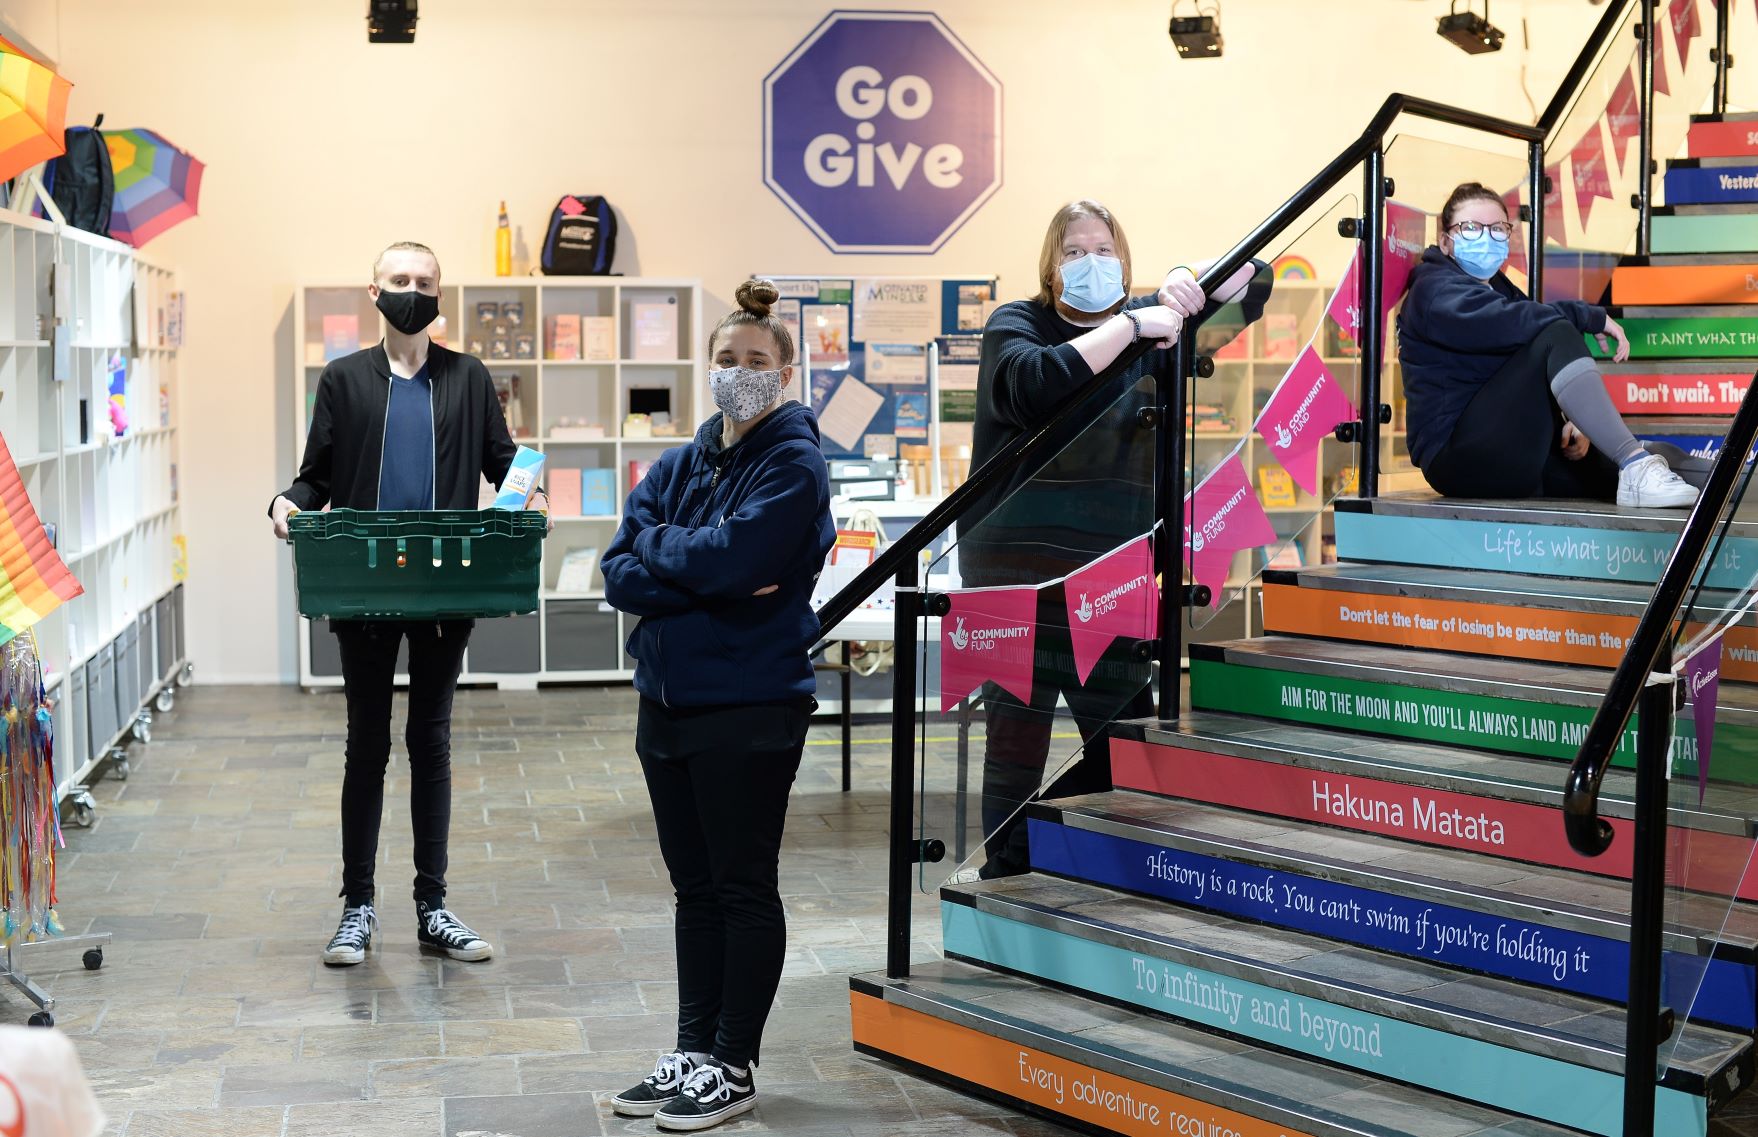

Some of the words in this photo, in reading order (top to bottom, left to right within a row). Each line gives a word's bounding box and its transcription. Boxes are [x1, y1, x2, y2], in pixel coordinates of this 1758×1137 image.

[835, 65, 933, 120] Go
[803, 121, 964, 191] Give
[1646, 333, 1657, 346] IT
[1661, 332, 1693, 346] AIN'T
[1696, 332, 1736, 345] WHAT
[1740, 332, 1758, 345] TH
[1288, 373, 1327, 429] COMMUNITY
[1627, 382, 1669, 403] Don't
[1673, 381, 1715, 403] wait.
[1292, 412, 1310, 437] FUND
[1202, 485, 1248, 535] COMMUNITY
[1206, 520, 1226, 544] FUND
[1484, 528, 1522, 563] Life
[1528, 529, 1545, 557] is
[1550, 536, 1600, 561] what
[1607, 544, 1647, 575] you
[1724, 542, 1741, 571] it
[1094, 574, 1149, 608] COMMUNITY
[1095, 600, 1118, 618] FUND
[970, 626, 1030, 640] COMMUNITY
[971, 640, 995, 651] FUND
[1339, 606, 1372, 624] Don't
[1373, 609, 1390, 626] let
[1392, 611, 1411, 628] the
[1414, 613, 1440, 631] fear
[1441, 616, 1456, 632] of
[1458, 617, 1494, 638] losing
[1496, 621, 1513, 638] be
[1515, 626, 1562, 643] greater
[1565, 628, 1596, 647] than
[1599, 632, 1622, 649] the
[1281, 685, 1302, 708] AIM
[1305, 688, 1328, 712] FOR
[1329, 691, 1352, 715] THE
[1355, 695, 1391, 721] MOON
[1394, 700, 1418, 724] AND
[1422, 704, 1465, 731] YOU'LL
[1468, 710, 1519, 738] ALWAYS
[1522, 717, 1557, 743] LAND
[1312, 780, 1404, 827] Hakuna
[1412, 797, 1505, 845] Matata
[1147, 850, 1205, 899] History
[1210, 869, 1222, 892] is
[1227, 879, 1237, 896] a
[1241, 875, 1278, 913] rock.
[1282, 884, 1314, 914] You
[1319, 898, 1361, 924] can't
[1366, 907, 1411, 936] swim
[1416, 908, 1432, 951] if
[1433, 923, 1490, 955] you're
[1496, 924, 1568, 982] holding
[1573, 946, 1591, 974] it
[1132, 957, 1157, 994] To
[1163, 967, 1244, 1026] infinity
[1251, 996, 1292, 1033] and
[1298, 1002, 1383, 1058] beyond
[1018, 1051, 1065, 1104] Every
[1072, 1075, 1160, 1126] adventure
